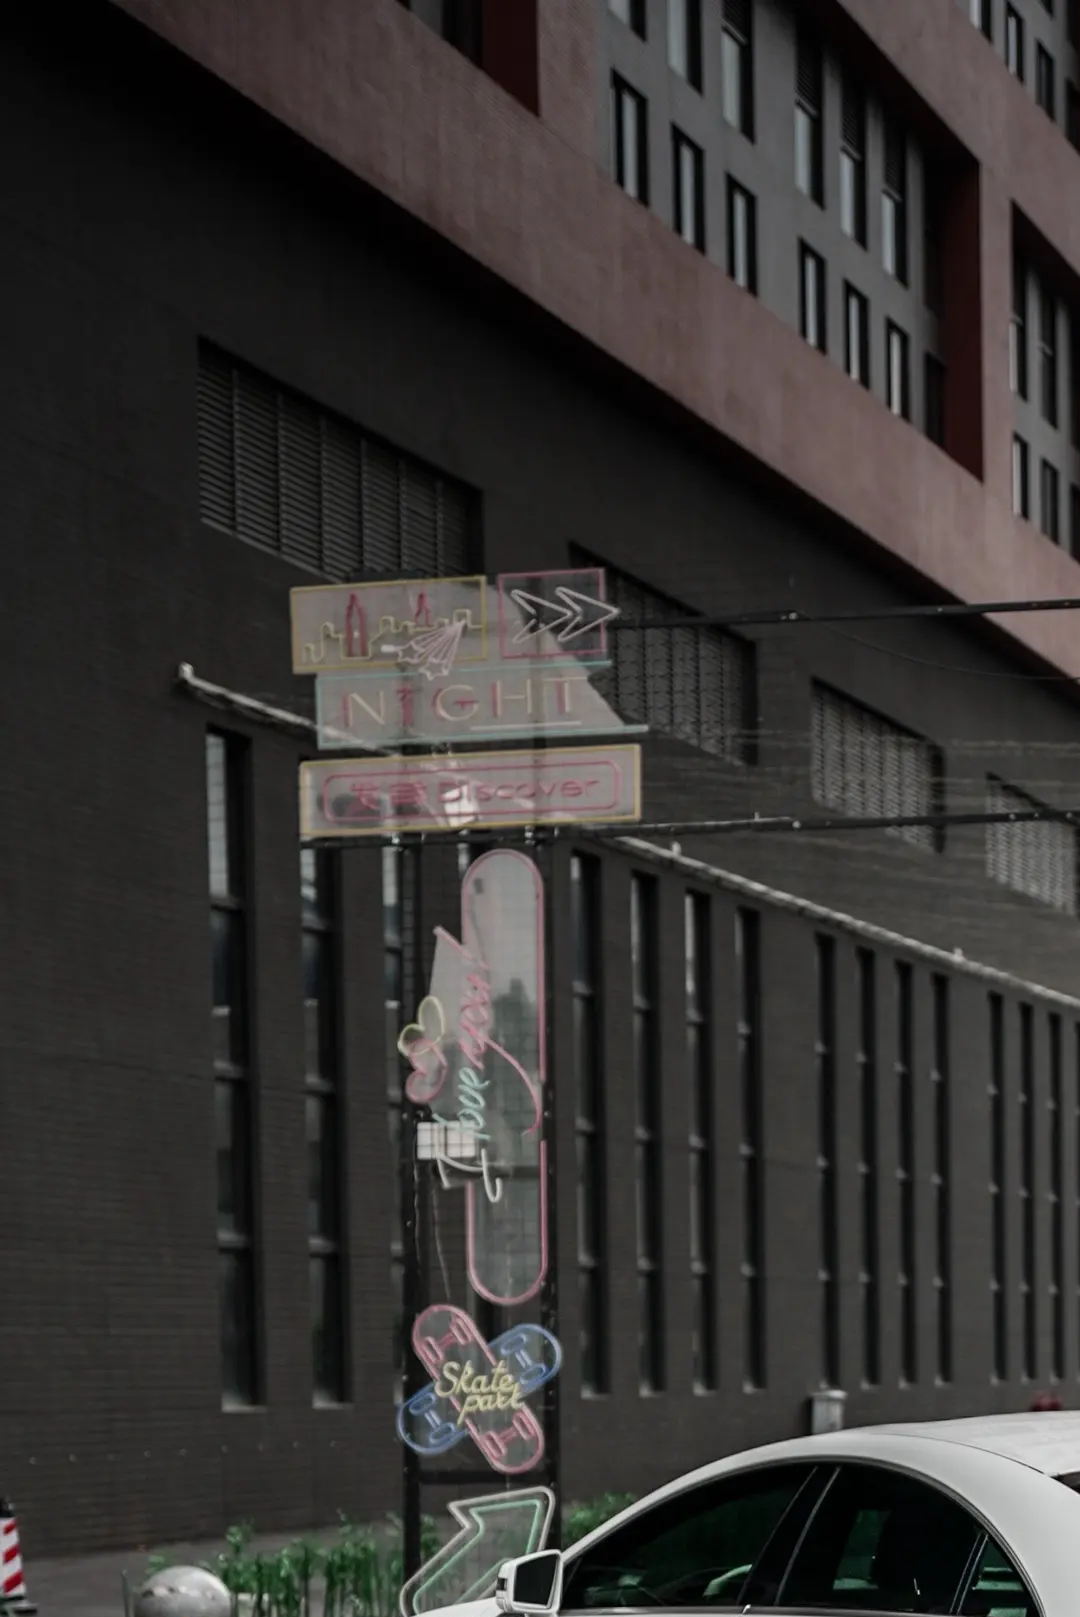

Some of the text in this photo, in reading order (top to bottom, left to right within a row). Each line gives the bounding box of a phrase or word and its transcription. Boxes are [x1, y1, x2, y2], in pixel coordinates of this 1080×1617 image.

[342, 676, 588, 728] NIGHT
[438, 779, 600, 803] Discover
[435, 1360, 515, 1398] Skate
